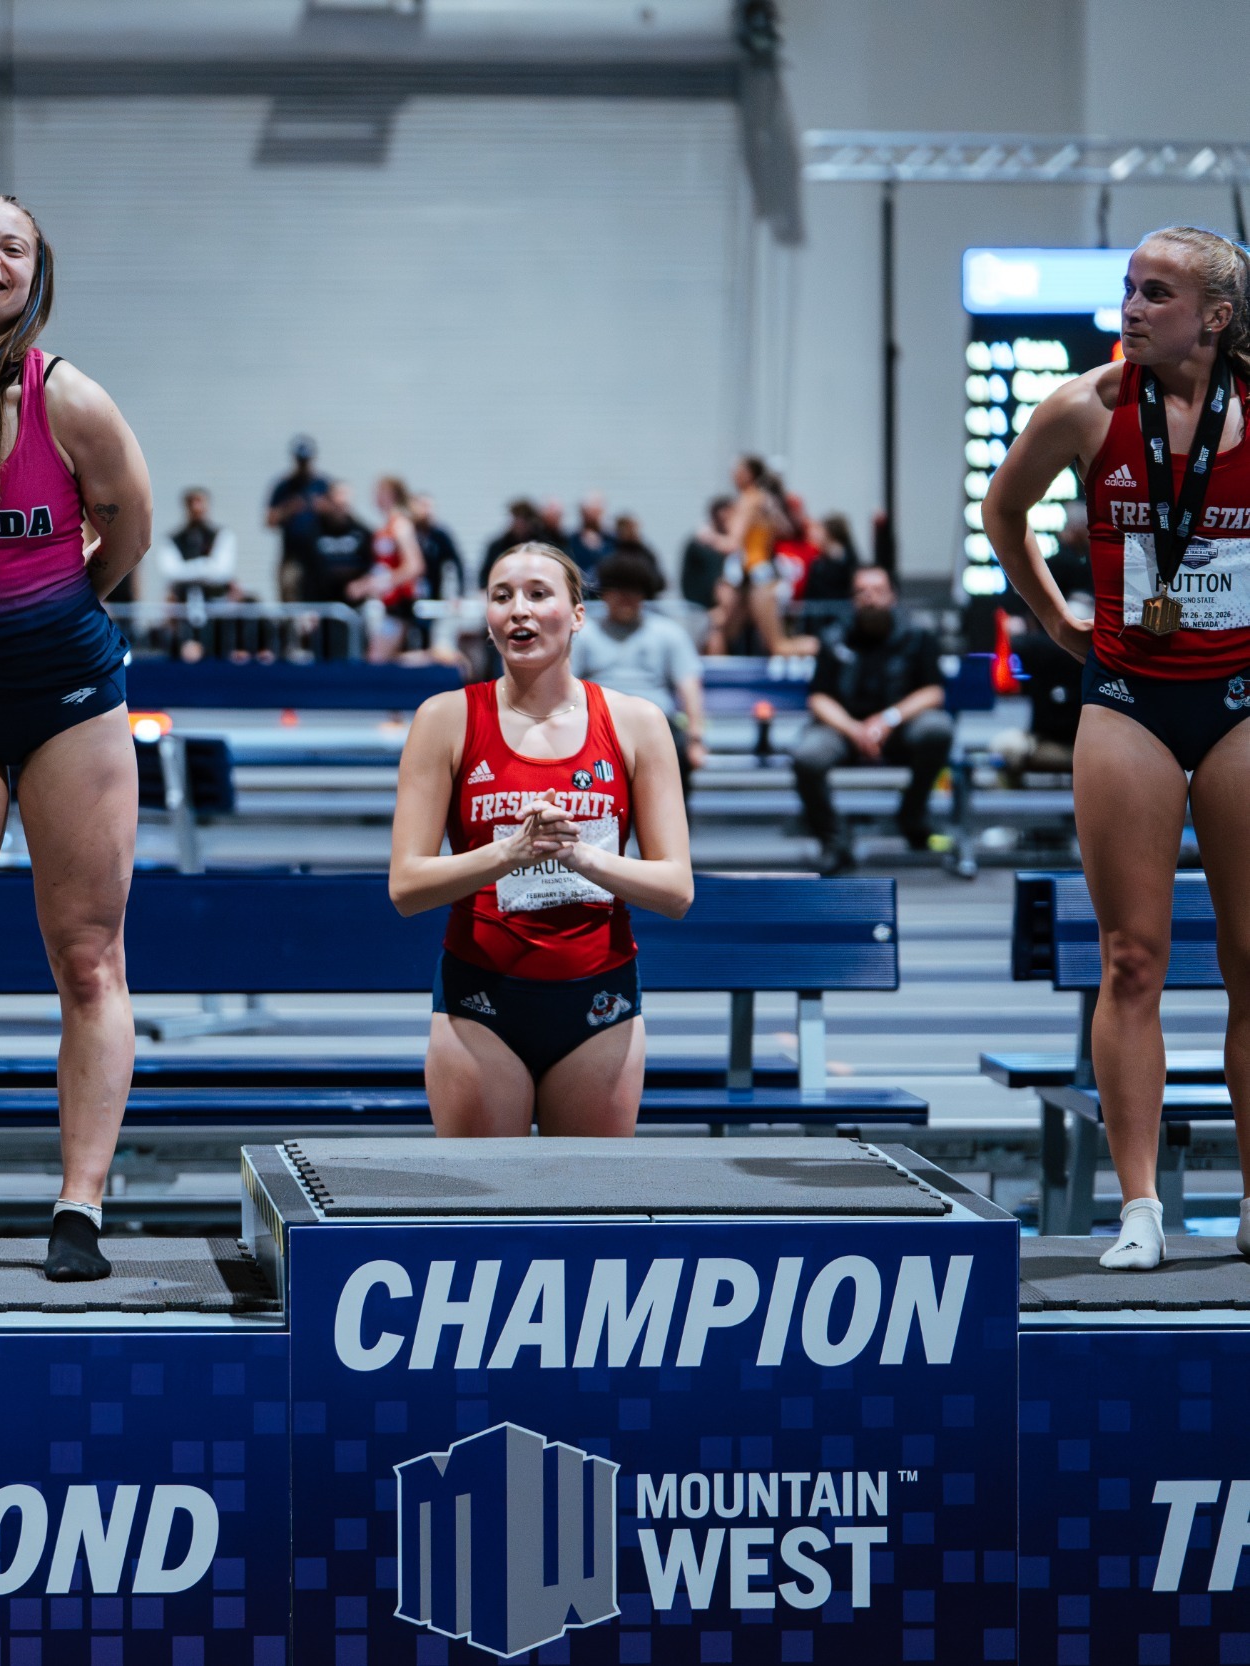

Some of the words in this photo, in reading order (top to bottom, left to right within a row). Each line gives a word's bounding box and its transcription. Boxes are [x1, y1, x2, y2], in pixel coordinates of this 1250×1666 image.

[1104, 478, 1137, 488] adidas
[1110, 500, 1151, 526] FRE
[1098, 685, 1135, 704] adidas
[467, 773, 495, 785] adidas
[554, 791, 615, 818] STATE
[460, 999, 497, 1016] adidas
[334, 1255, 974, 1372] CHAMPION
[637, 1471, 888, 1518] MOUNTAIN
[638, 1526, 888, 1610] WEST
